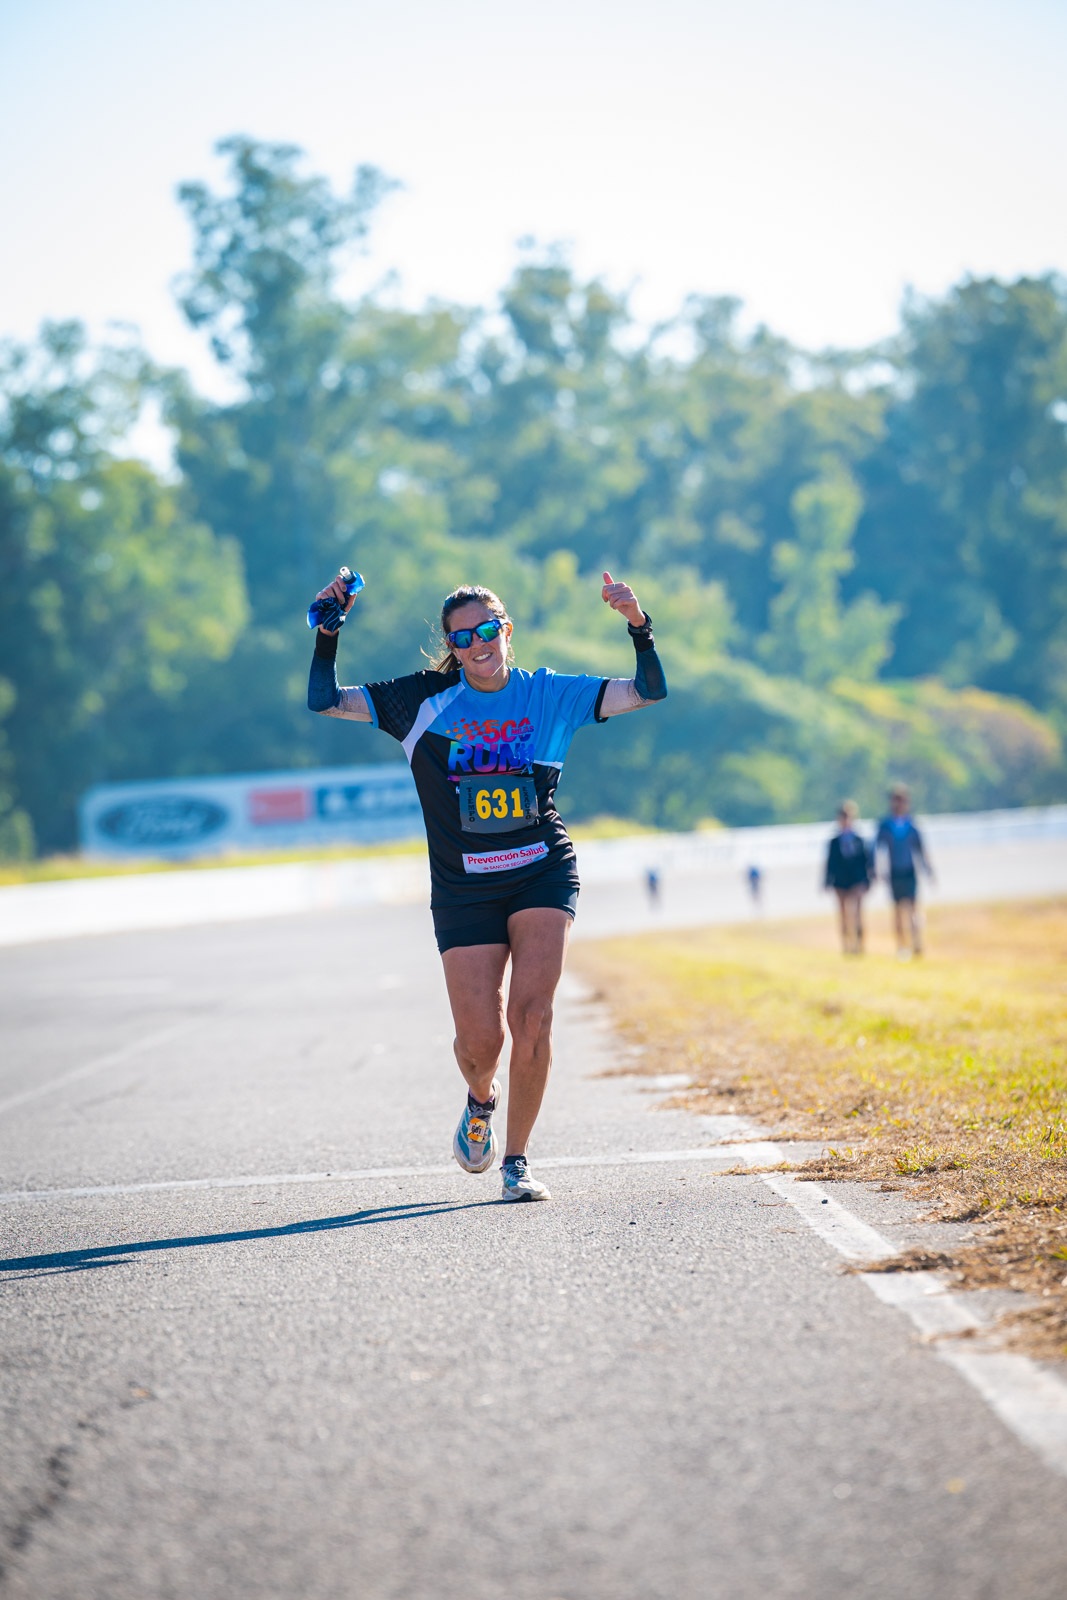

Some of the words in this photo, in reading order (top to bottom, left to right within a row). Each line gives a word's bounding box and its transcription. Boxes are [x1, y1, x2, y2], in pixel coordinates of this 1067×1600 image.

[482, 717, 531, 743] 500
[448, 741, 526, 773] RUN
[466, 787, 476, 822] TIEMPO
[476, 788, 523, 819] 631
[522, 786, 532, 819] EXACTO
[467, 853, 519, 864] Prevención
[519, 845, 545, 857] Salud
[510, 858, 533, 867] SEGUROS
